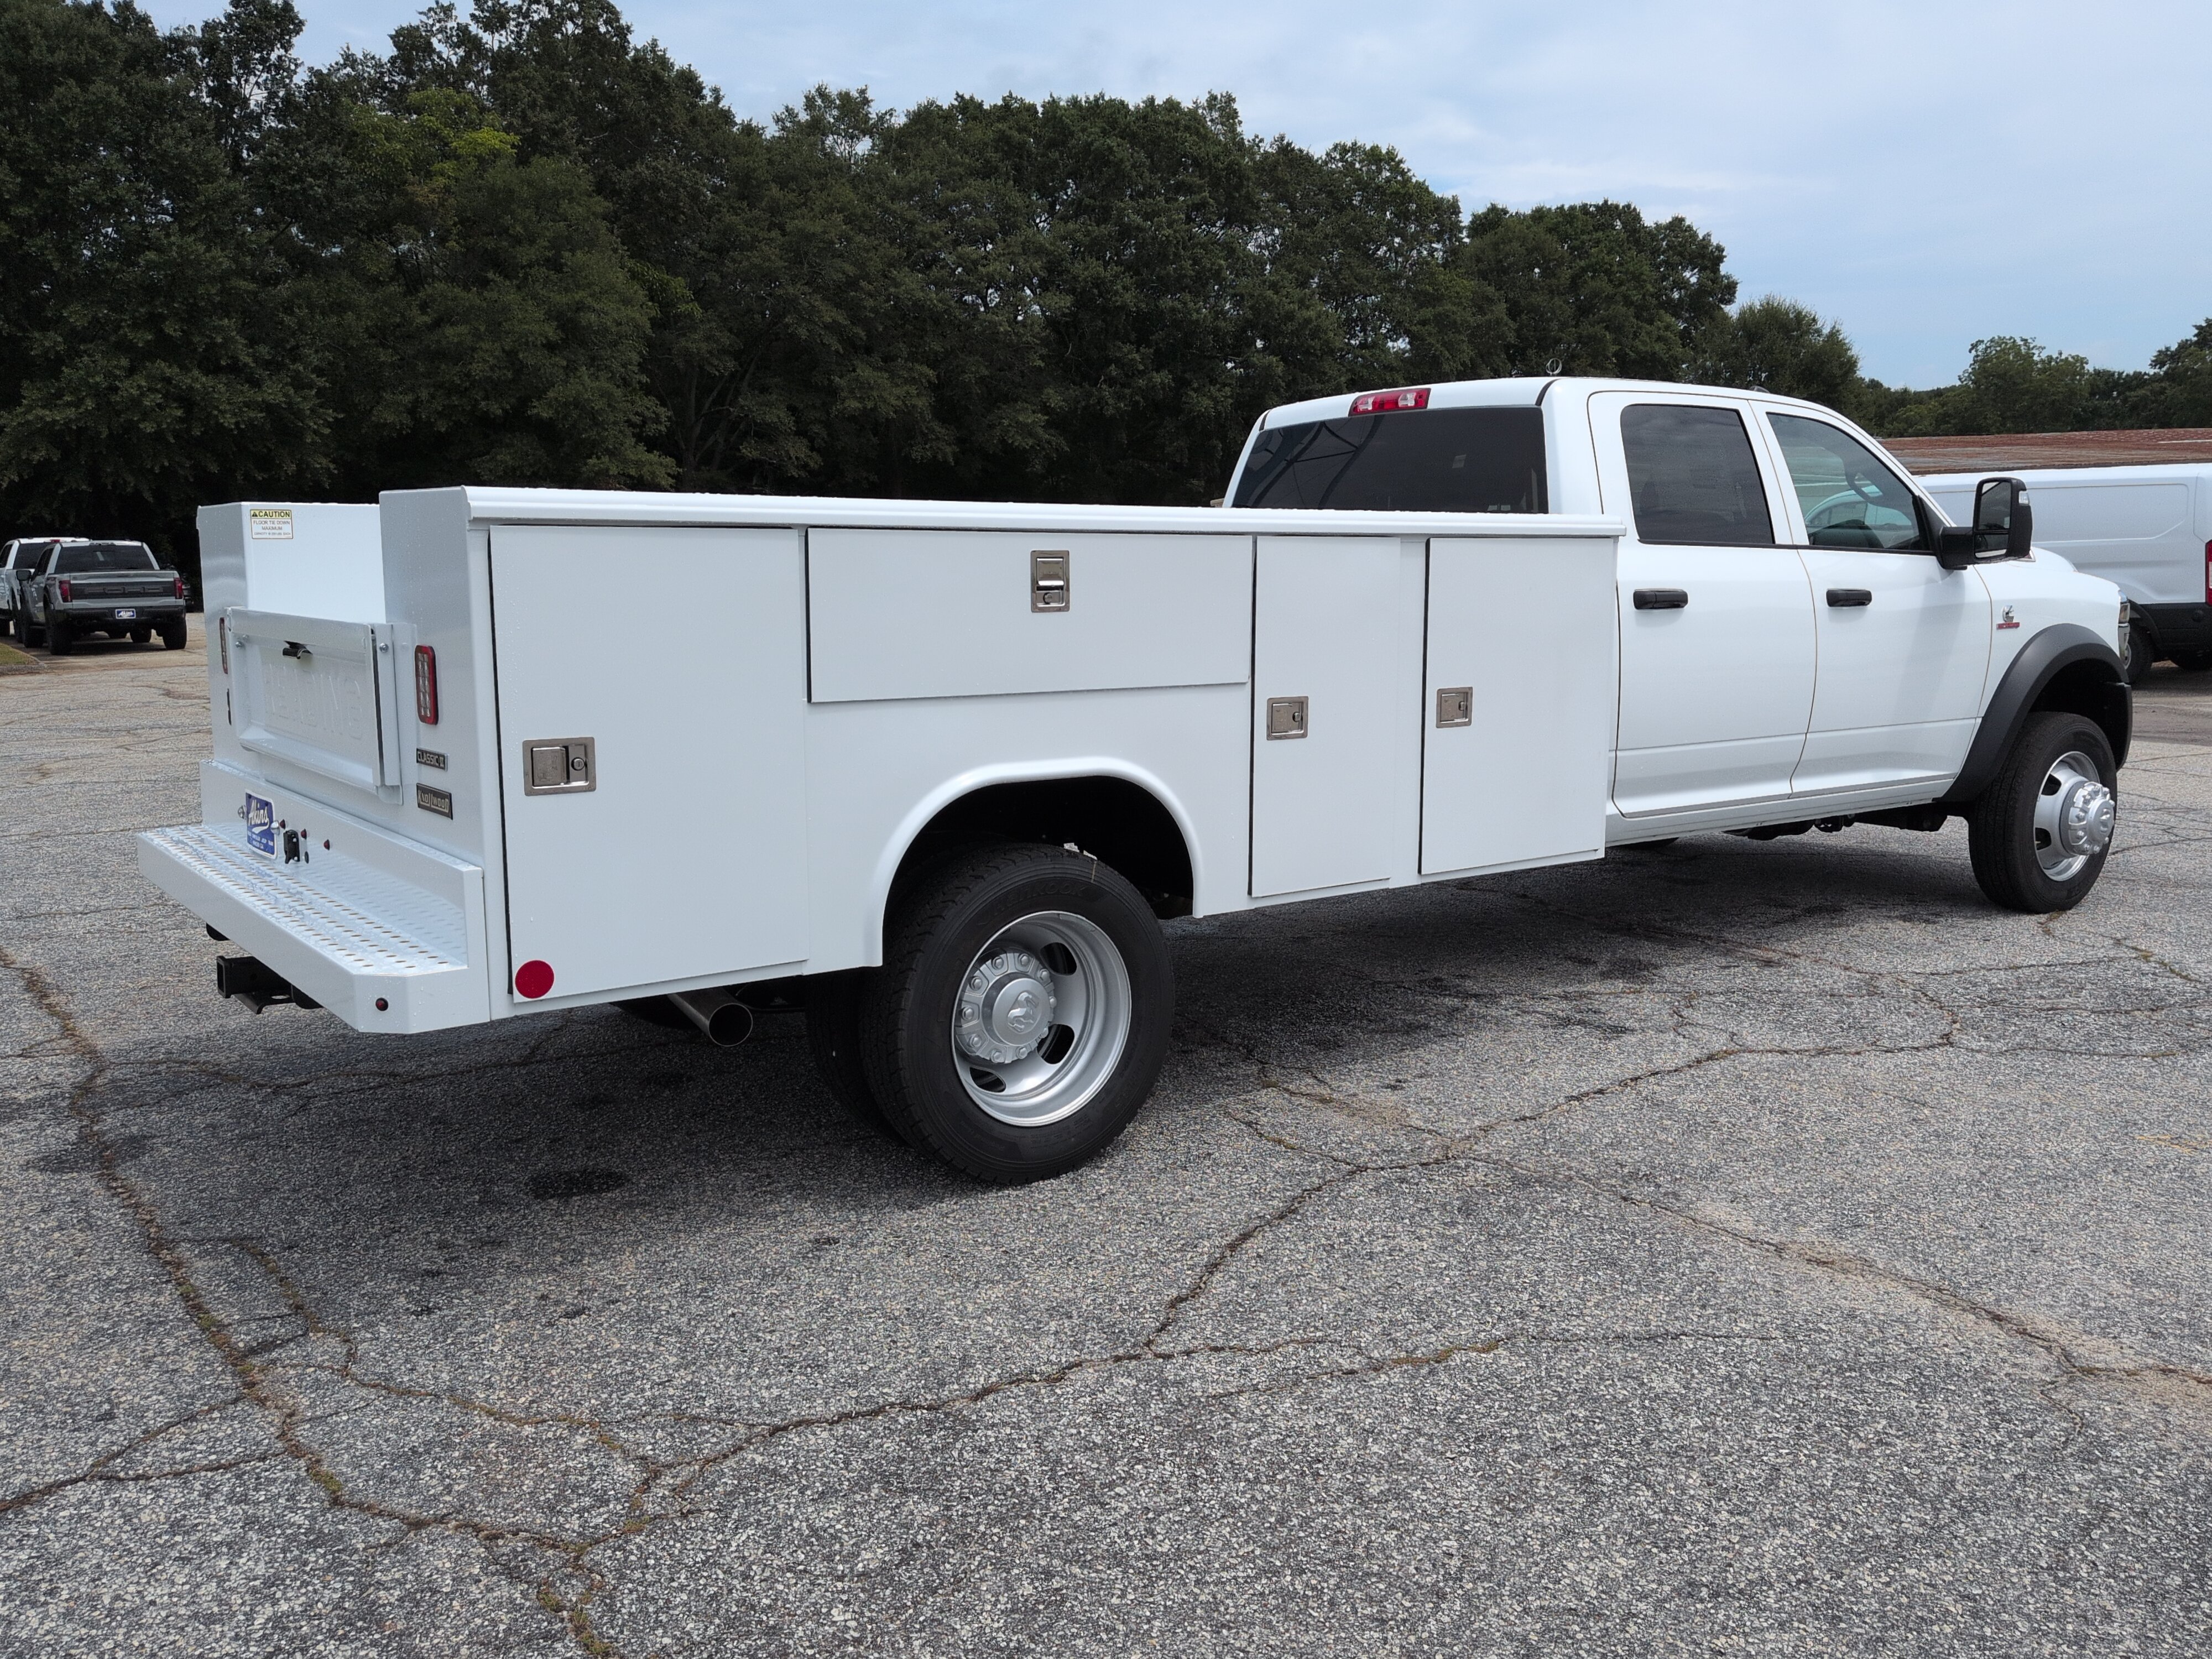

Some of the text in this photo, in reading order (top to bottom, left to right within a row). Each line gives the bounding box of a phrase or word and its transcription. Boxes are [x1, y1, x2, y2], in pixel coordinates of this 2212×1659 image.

[418, 752, 444, 768] CLASSIC II
[248, 800, 269, 826] Akins
